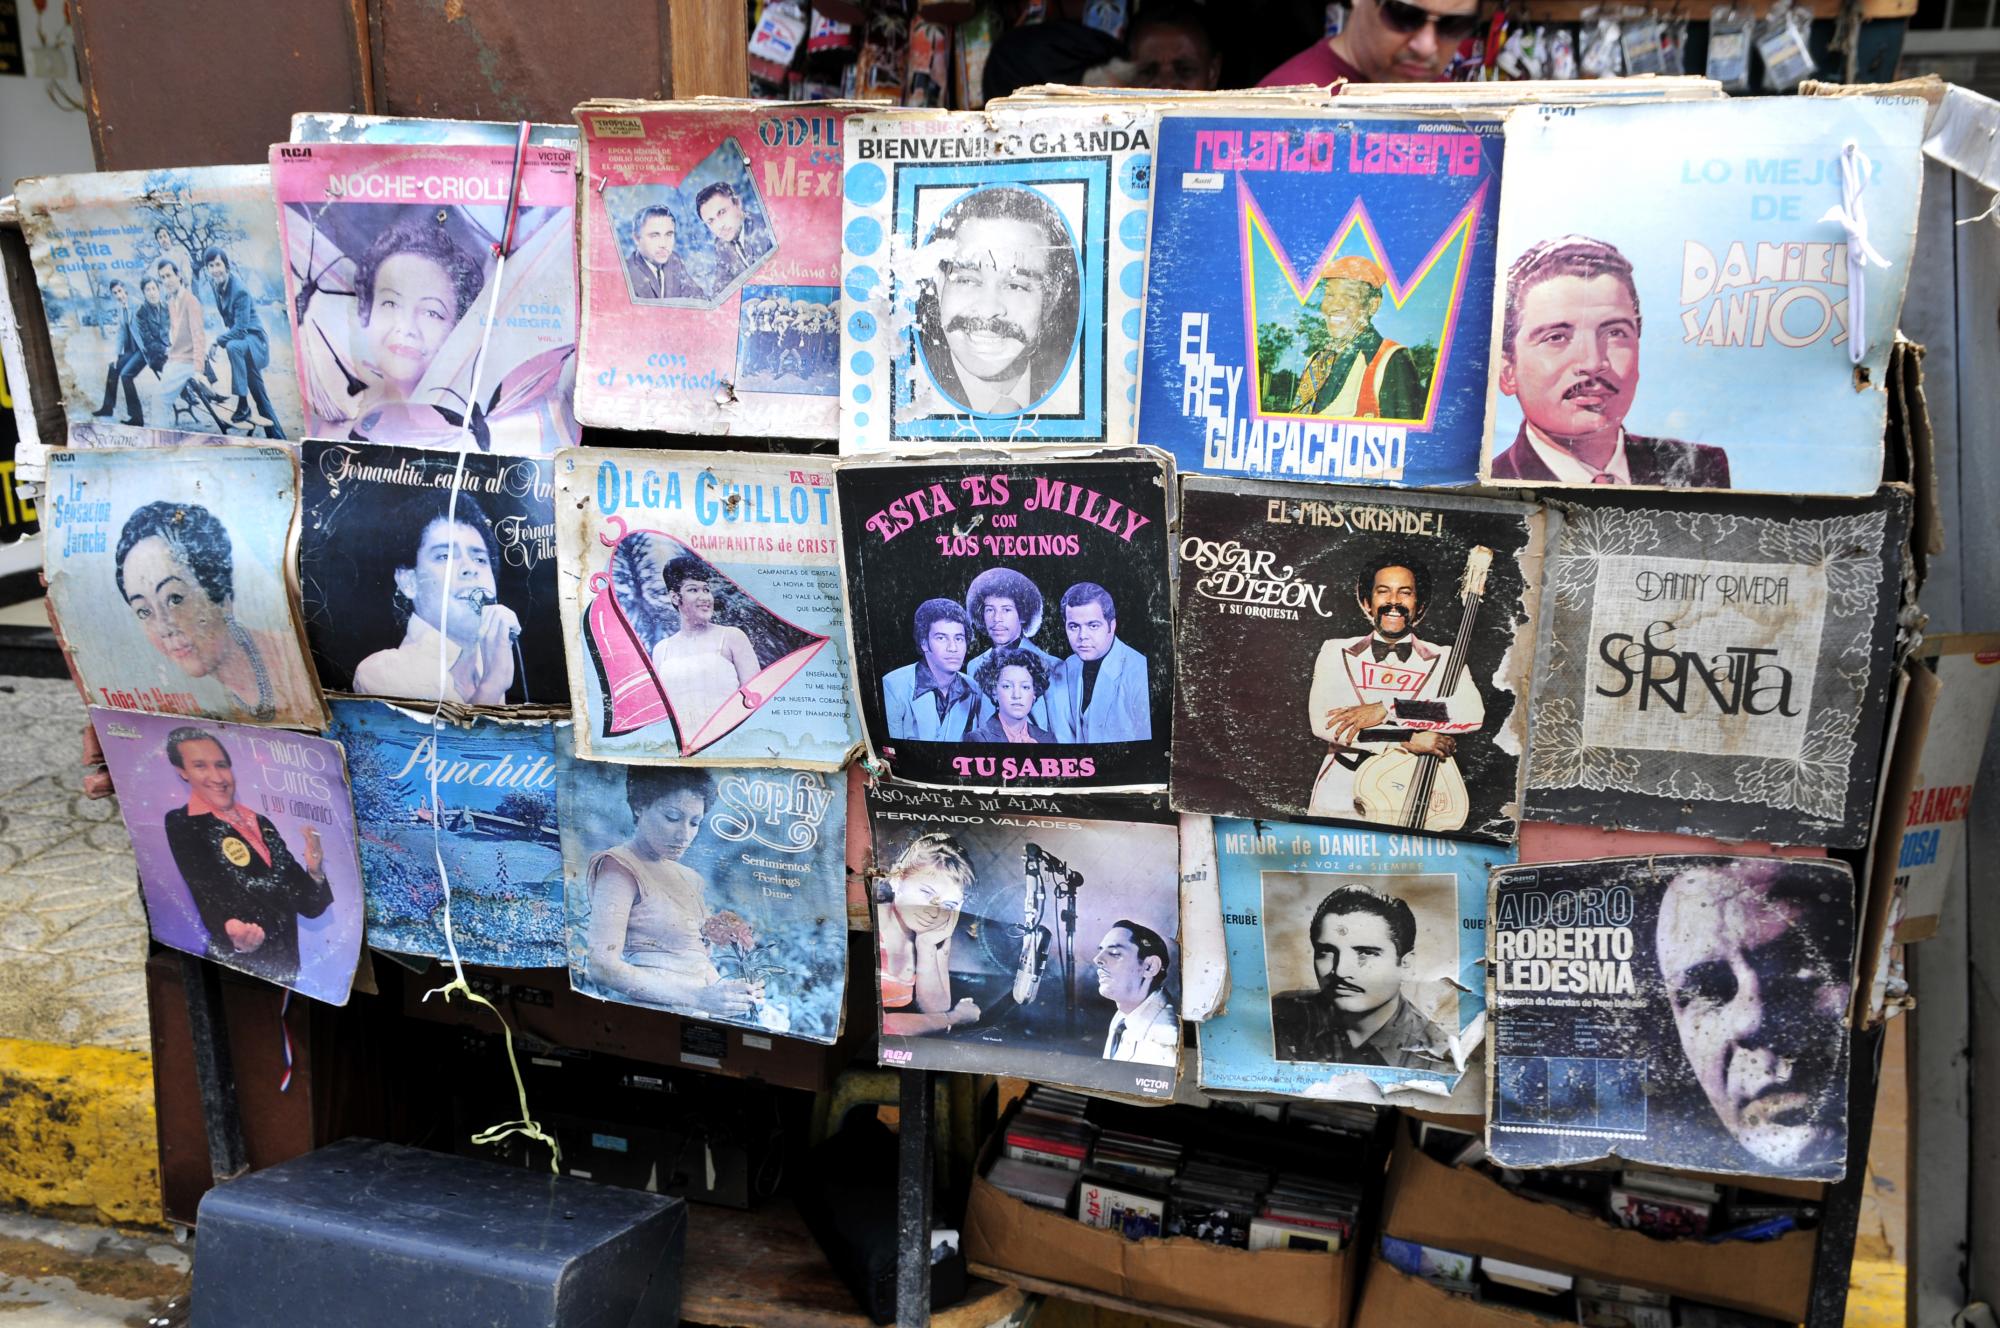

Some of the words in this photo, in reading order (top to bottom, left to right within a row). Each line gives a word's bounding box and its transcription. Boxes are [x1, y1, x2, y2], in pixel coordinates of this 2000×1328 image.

[281, 147, 312, 158] RCA
[538, 152, 571, 161] VICTOR
[1680, 158, 1732, 185] LO
[328, 174, 417, 198] NOCHE
[1751, 195, 1802, 222] DE
[49, 245, 70, 259] la
[56, 262, 107, 273] quiera
[506, 316, 561, 329] NEGRA
[1180, 312, 1216, 366] EL
[1182, 365, 1244, 418] REY
[51, 453, 75, 462] RCA
[1203, 416, 1408, 480] GUAPACHOSO
[485, 466, 505, 494] al
[597, 460, 683, 515] OLGA
[865, 483, 956, 543] ESTA
[960, 474, 1009, 508] ES
[1023, 476, 1151, 543] MILLY
[1266, 499, 1292, 524] EL
[1299, 501, 1345, 528] MAS
[991, 514, 1017, 529] CON
[690, 534, 773, 552] CAMPANITAS
[778, 537, 793, 553] de
[935, 535, 980, 557] LOS
[982, 534, 1080, 557] VECINOS
[1180, 536, 1294, 582] OSCAR
[757, 568, 798, 576] CAMPANITAS
[1636, 570, 1711, 602] DANNY
[1715, 575, 1789, 606] RIVERA
[1218, 603, 1226, 614] Y
[1229, 604, 1243, 615] SU
[1245, 606, 1299, 621] ORQUESTA
[805, 671, 838, 679] ENSEÑAME
[805, 710, 851, 719] ENAMORANDO
[952, 757, 996, 777] TU
[1001, 757, 1096, 780] SABES
[870, 785, 955, 808] ASOMATE
[960, 794, 973, 807] A
[979, 798, 1001, 812] MI
[1007, 796, 1062, 813] ALMA
[710, 771, 835, 854] Sophy
[875, 811, 984, 825] FERNANDO
[989, 817, 1082, 831] VALADES
[1292, 833, 1312, 856] de
[1319, 835, 1380, 857] DANIEL
[741, 853, 811, 873] Sentimientos
[1315, 861, 1340, 869] VOZ
[1347, 862, 1363, 870] de
[752, 871, 801, 888] Feelings
[761, 886, 793, 900] Dime
[1497, 886, 1634, 931] ADORO
[1222, 913, 1258, 926] ERUBE
[1496, 926, 1634, 961] ROBERTO
[1496, 960, 1636, 994] LEDESMA
[1535, 997, 1545, 1005] de
[1546, 997, 1580, 1007] Cuerdas
[1582, 998, 1592, 1007] de
[883, 1049, 912, 1061] RCA
[1136, 1077, 1169, 1090] VICTOR
